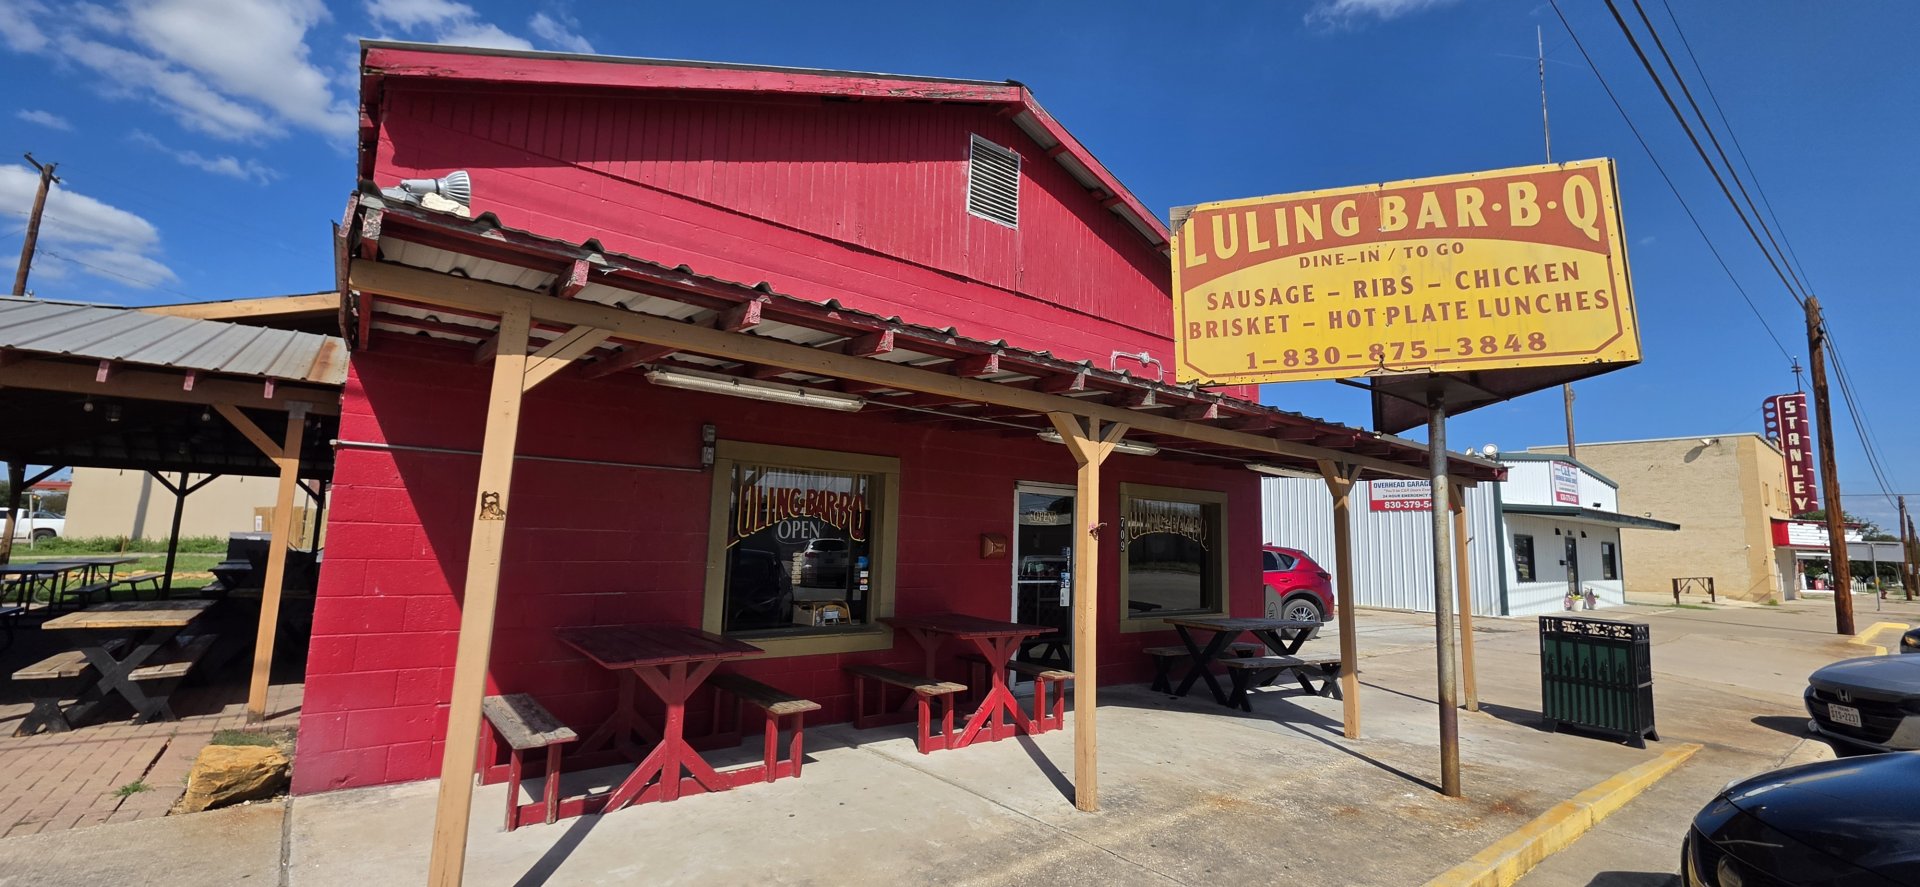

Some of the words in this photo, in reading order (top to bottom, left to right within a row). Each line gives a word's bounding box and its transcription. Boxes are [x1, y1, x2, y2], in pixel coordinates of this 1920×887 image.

[1184, 200, 1360, 268] LULING
[1404, 245, 1429, 258] TO
[1436, 242, 1465, 256] GO
[1206, 284, 1315, 311] SAUSAGE
[1353, 276, 1414, 299] RIBS
[1454, 261, 1581, 290] CHICKEN
[1189, 314, 1290, 340] BRISKET
[1329, 307, 1377, 330] HOT
[1386, 300, 1469, 325] PLATE
[1478, 289, 1610, 319] LUNCHES
[1246, 331, 1548, 370] 1-830-875-3848
[1784, 400, 1808, 510] STANLEY
[777, 520, 821, 539] OPEN
